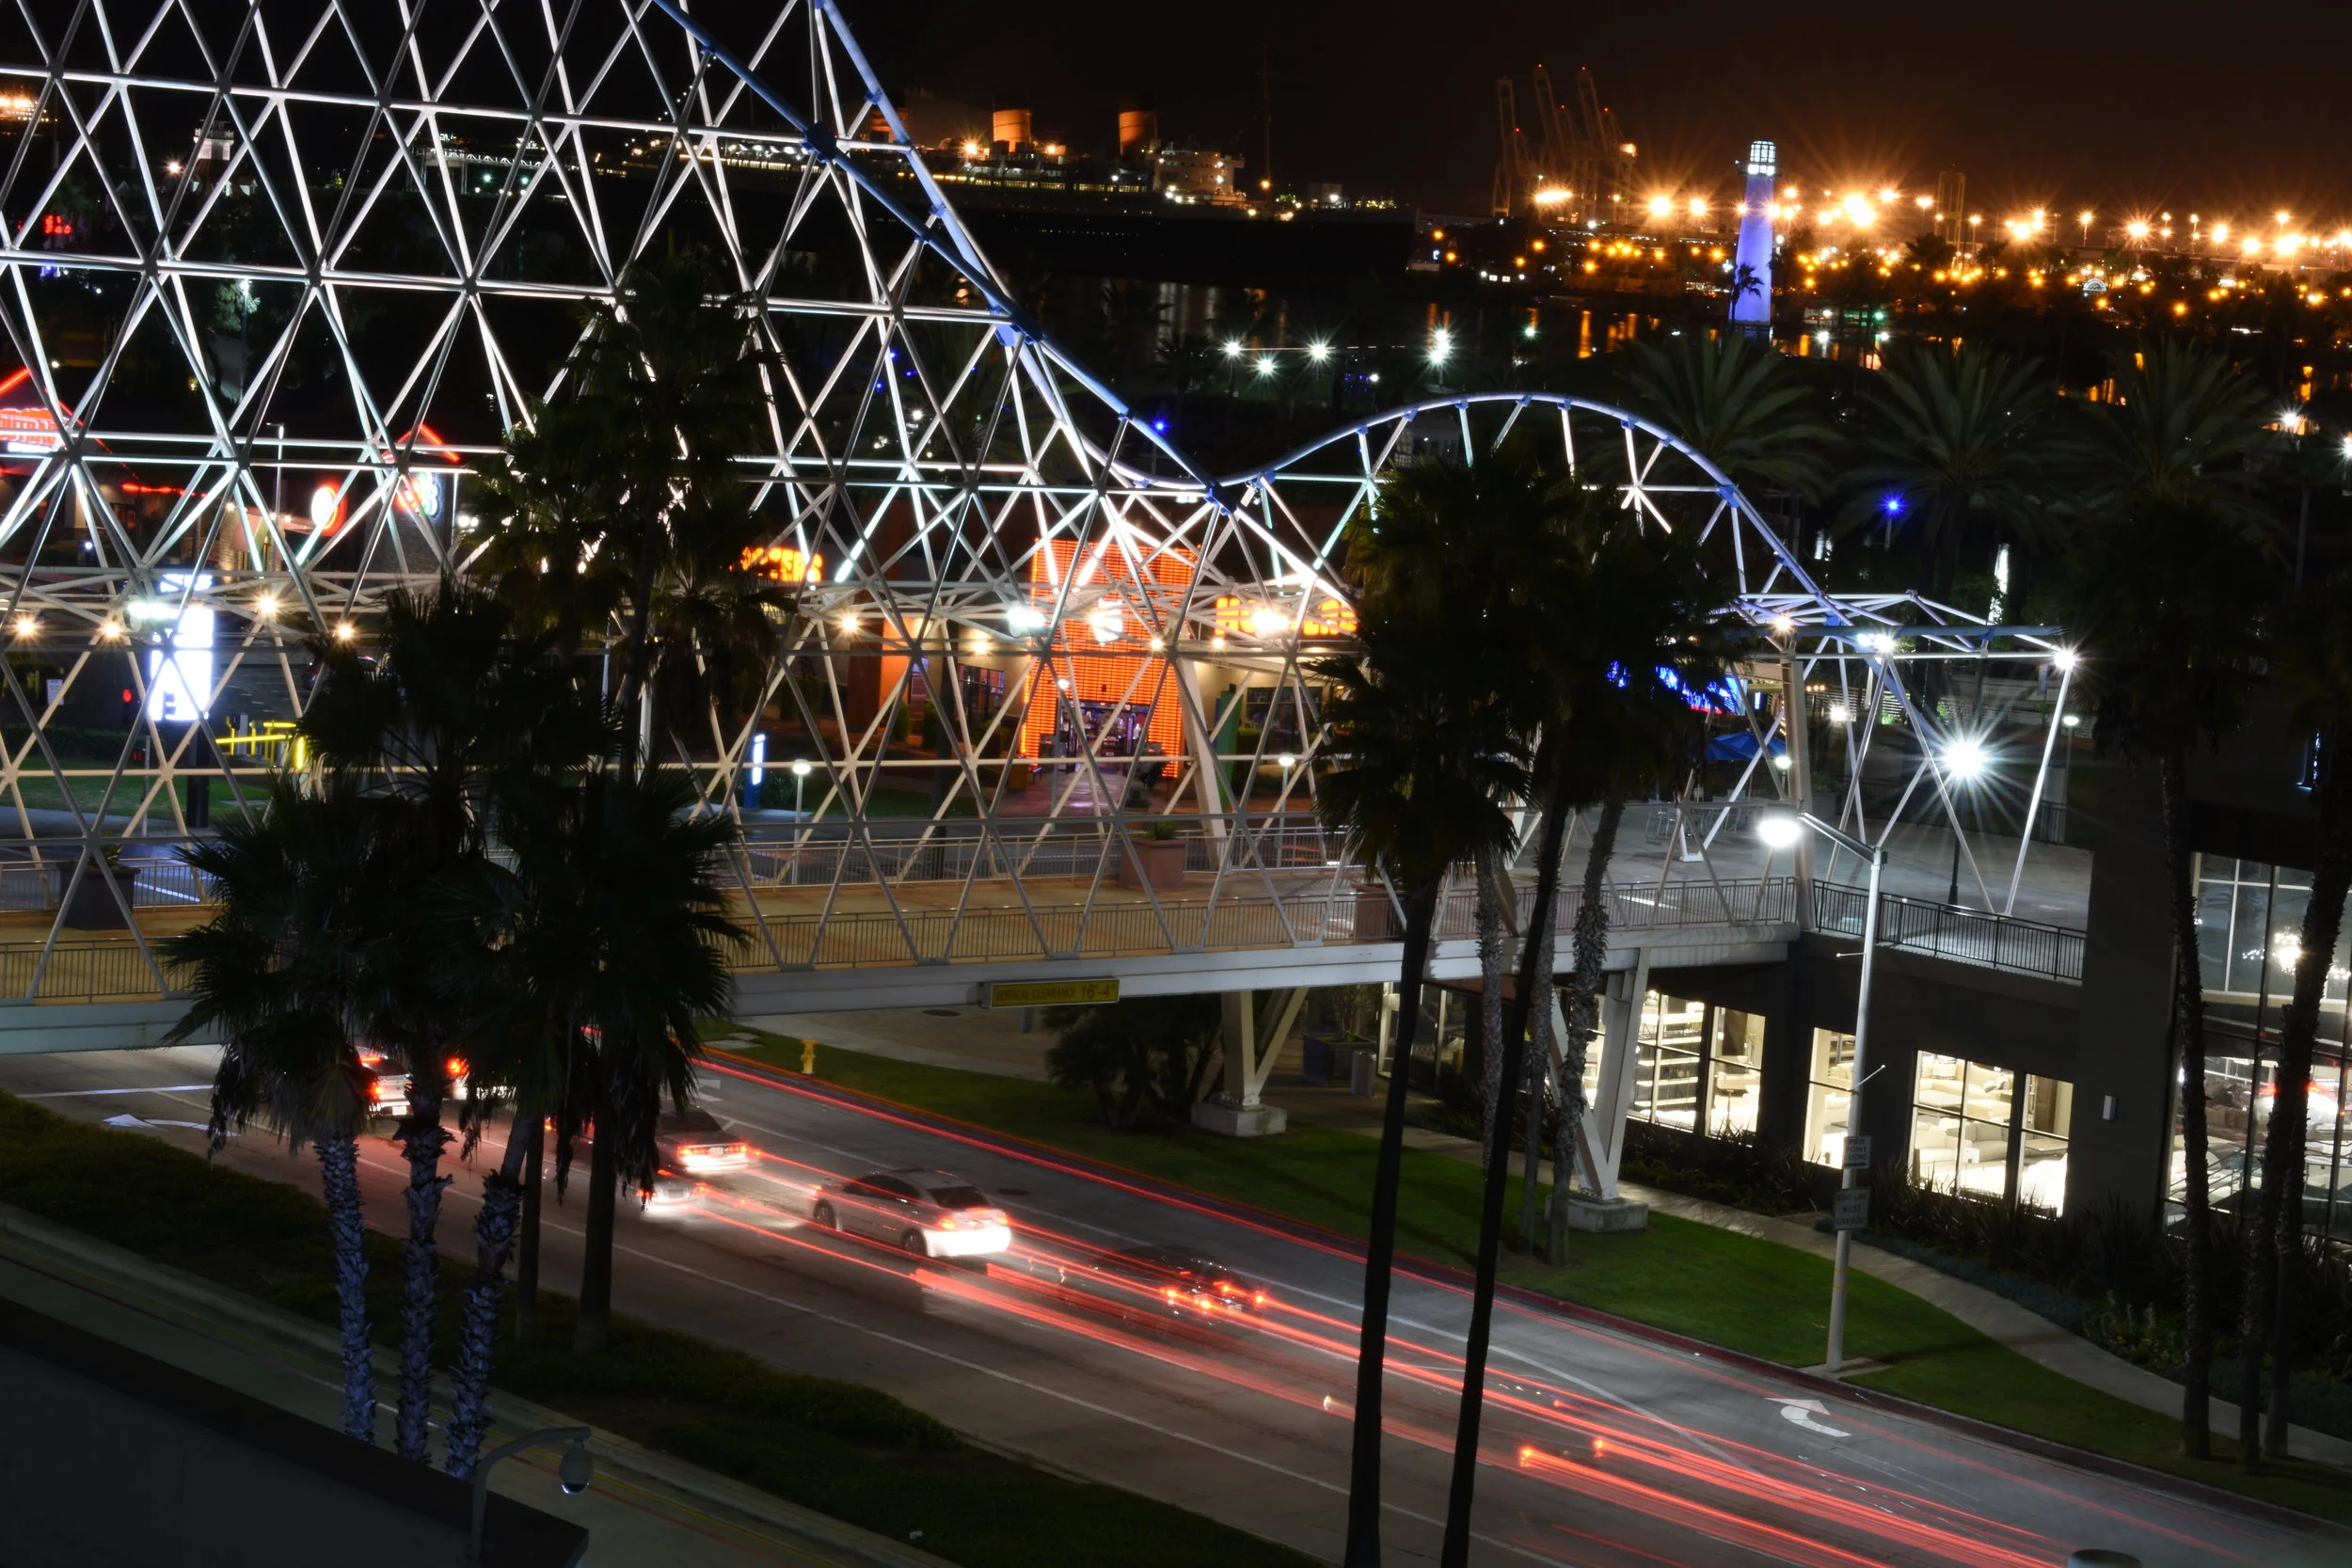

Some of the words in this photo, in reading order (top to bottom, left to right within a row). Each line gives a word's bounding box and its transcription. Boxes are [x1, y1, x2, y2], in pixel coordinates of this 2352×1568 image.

[995, 989, 1029, 1001] VERTICAL
[1031, 986, 1077, 999] CLEARANCE
[1842, 1205, 1861, 1213] MUST
